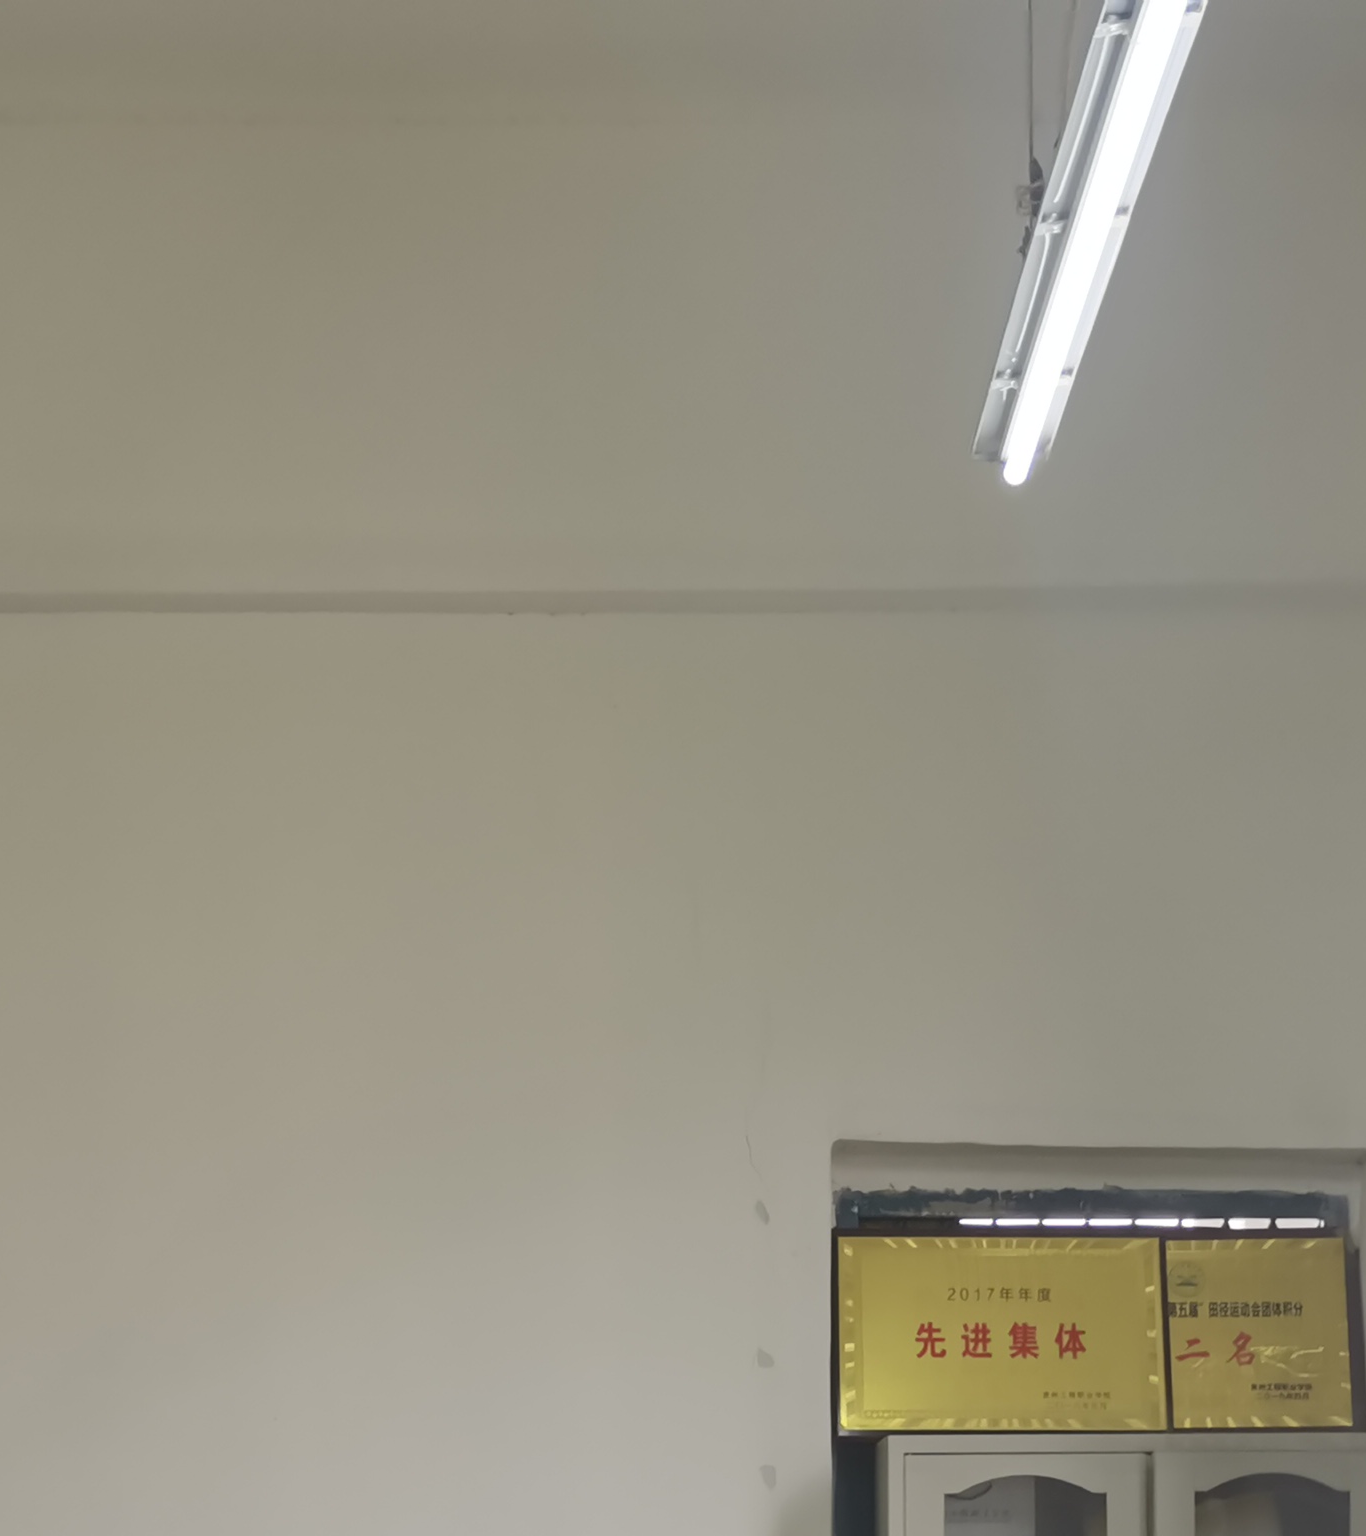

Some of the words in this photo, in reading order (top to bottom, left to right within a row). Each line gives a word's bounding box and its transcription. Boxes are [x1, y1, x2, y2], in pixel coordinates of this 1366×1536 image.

[947, 1287, 1052, 1303] 2017年年度
[915, 1321, 1086, 1360] 先进集体
